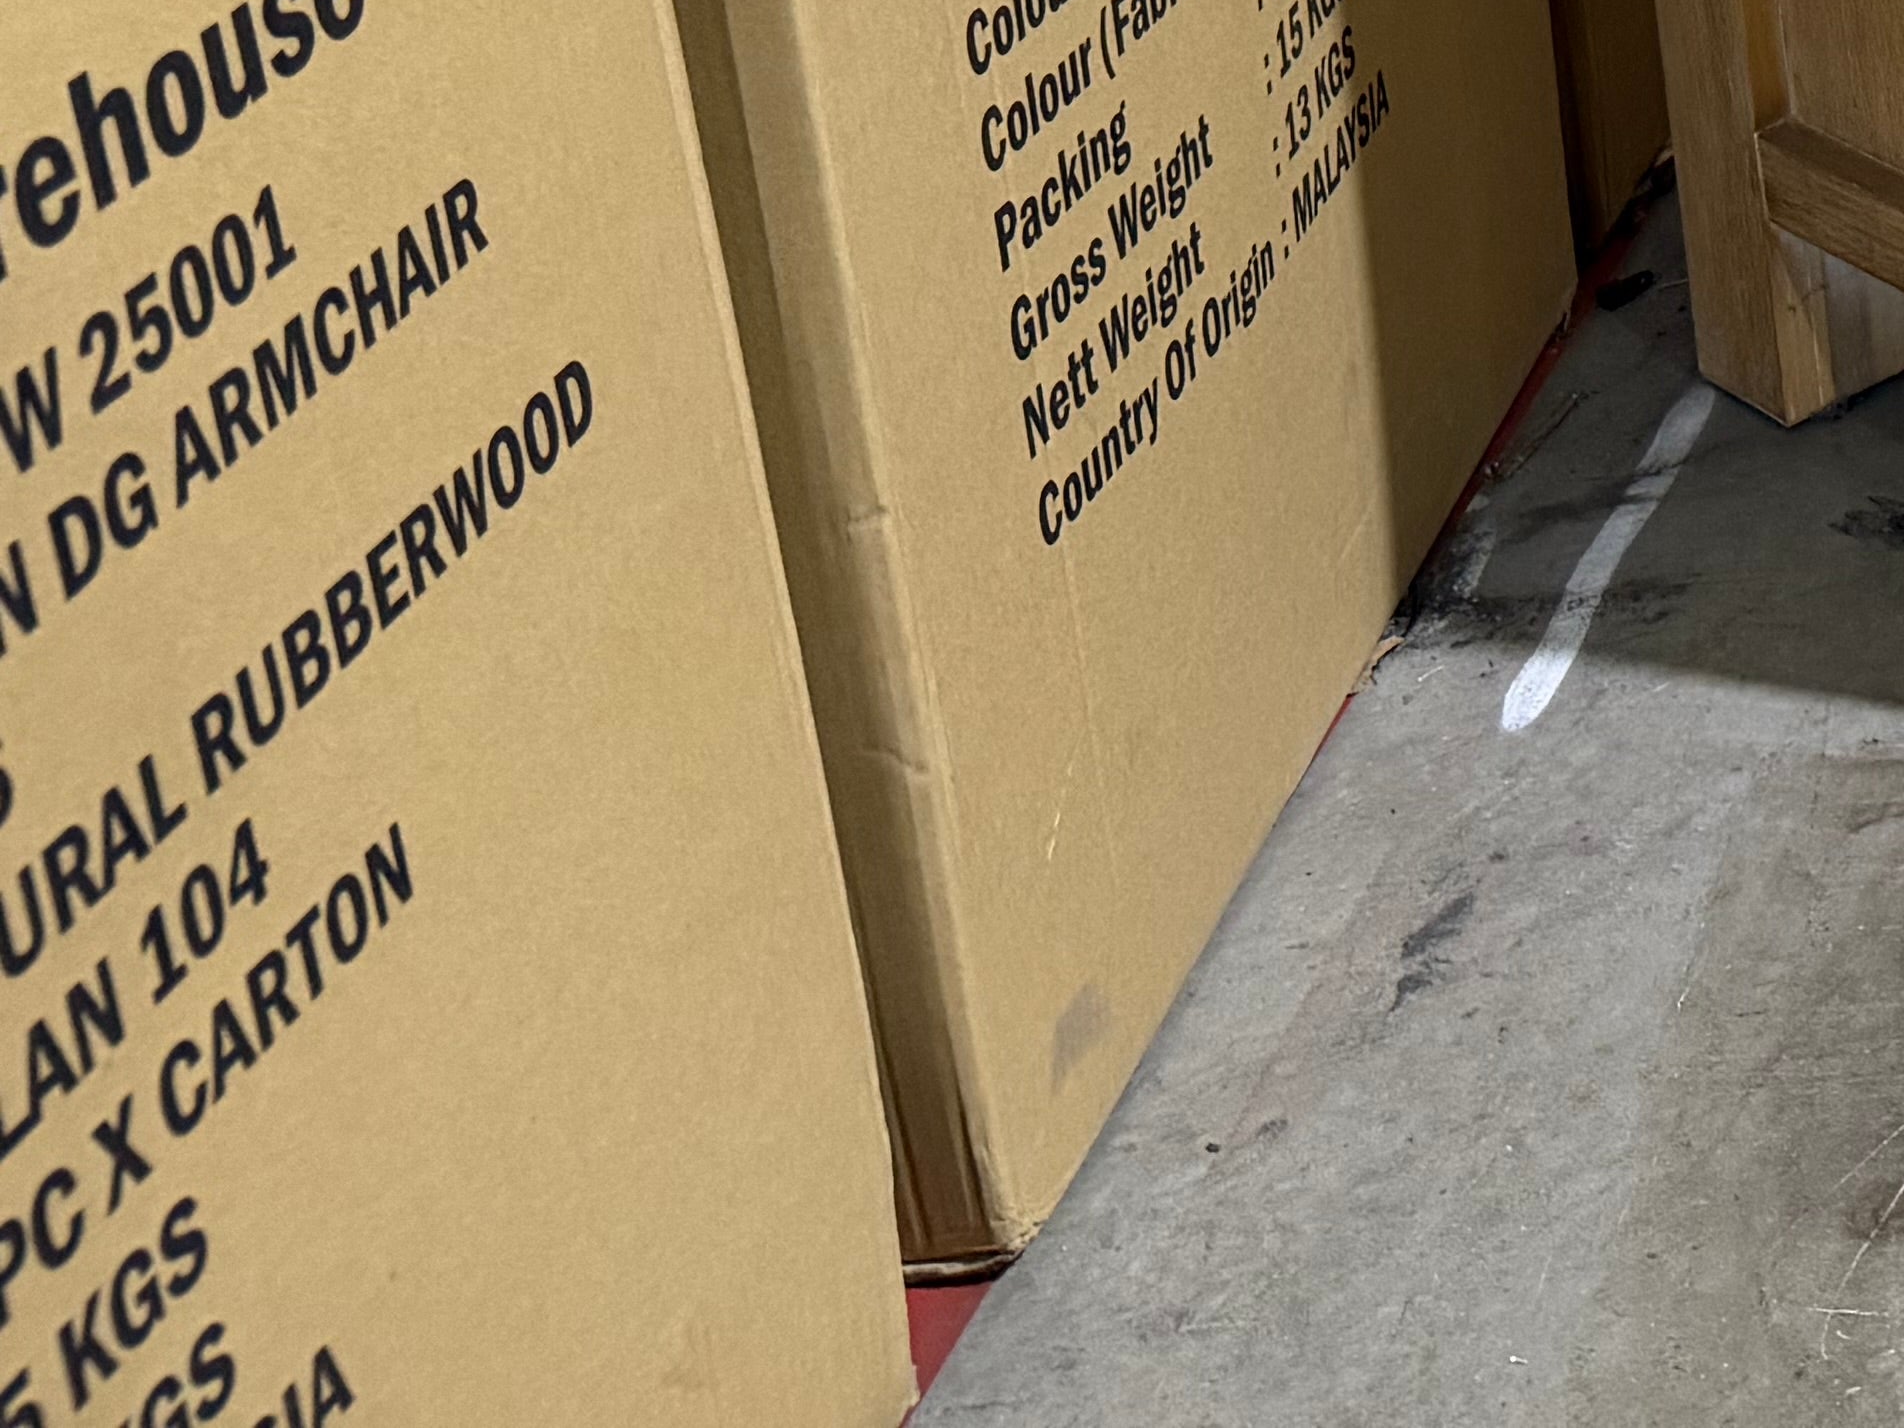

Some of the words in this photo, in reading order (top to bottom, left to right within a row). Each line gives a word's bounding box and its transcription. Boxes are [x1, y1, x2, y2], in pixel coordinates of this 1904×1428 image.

[980, 36, 1092, 173] Colour
[993, 99, 1132, 274] Packing
[1010, 236, 1107, 361] Gross
[1107, 113, 1214, 261] Weight
[1276, 0, 1304, 80] 15
[1021, 337, 1100, 461] Nett
[1098, 221, 1206, 374] Weight
[1284, 83, 1312, 161] 13
[1314, 12, 1357, 121] KGS
[46, 451, 159, 602] DG
[174, 177, 489, 510] ARMCHAIR
[77, 183, 298, 416] 25001
[1038, 375, 1159, 546] Country
[1164, 317, 1197, 401] Of
[1201, 240, 1276, 358] Origin
[1291, 68, 1390, 244] MALAYSIA
[189, 359, 593, 797] RUBBERWOOD
[90, 1092, 154, 1217] X
[158, 821, 414, 1138] CARTON
[139, 817, 270, 1006] 104
[56, 1195, 209, 1413] KGS
